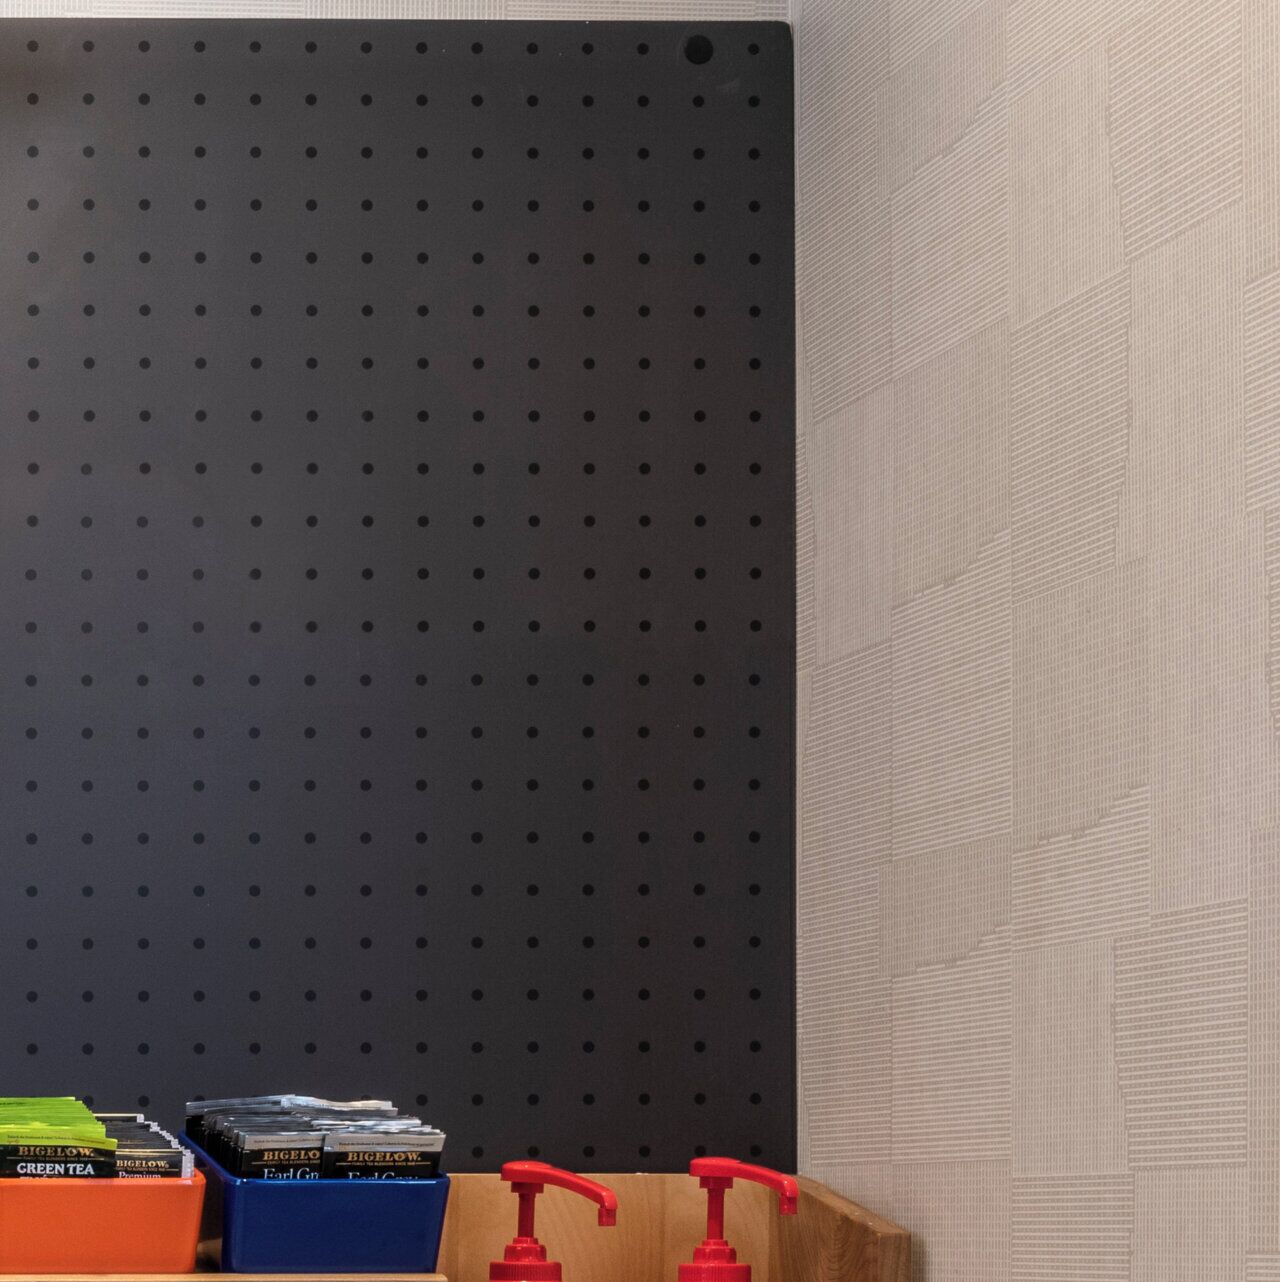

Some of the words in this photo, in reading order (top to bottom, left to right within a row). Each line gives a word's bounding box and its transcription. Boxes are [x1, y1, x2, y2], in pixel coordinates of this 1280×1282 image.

[263, 1150, 321, 1160] BIGELO
[17, 1162, 65, 1175] GREEN
[66, 1163, 95, 1175] TEA
[264, 1168, 293, 1179] Earl
[297, 1168, 320, 1179] Gr
